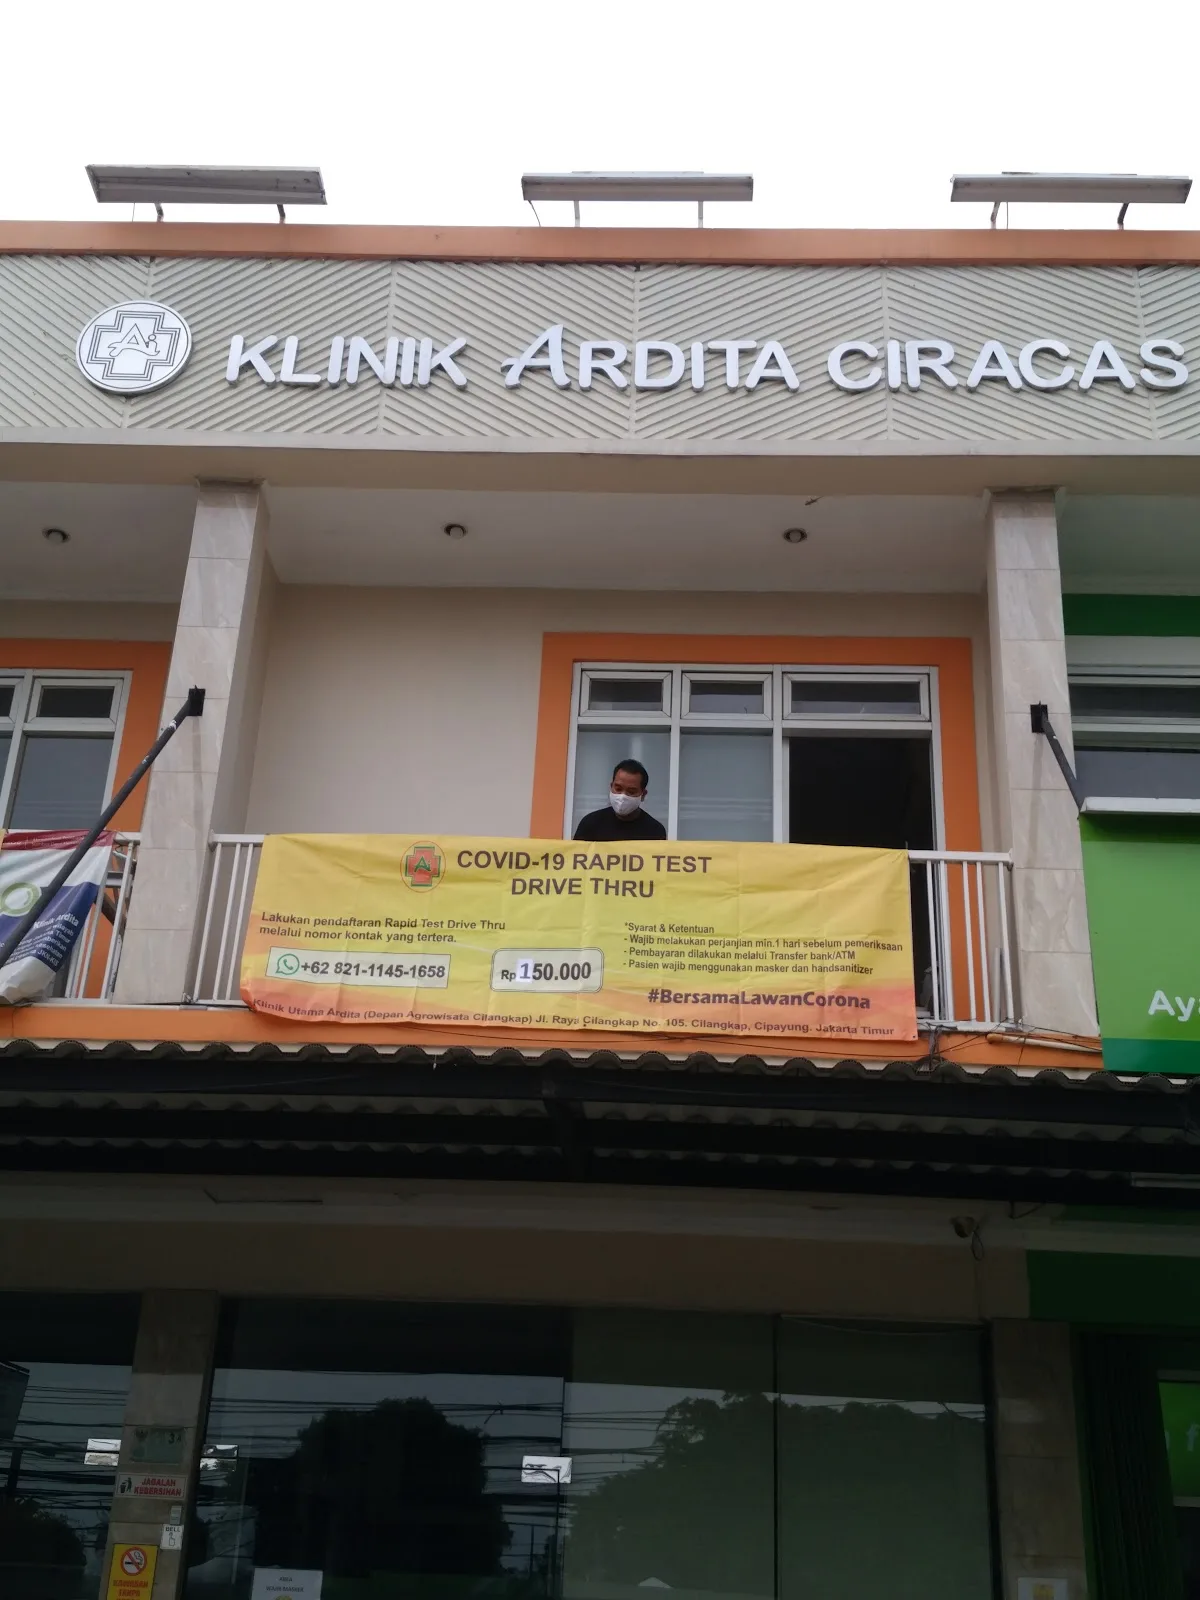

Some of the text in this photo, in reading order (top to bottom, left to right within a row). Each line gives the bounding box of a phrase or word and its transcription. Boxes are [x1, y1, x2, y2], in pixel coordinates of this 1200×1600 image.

[225, 324, 1189, 393] KLINIK ARDITA CIRACAS
[457, 850, 712, 874] COVID-19 RAPID TEST
[511, 878, 654, 898] DRIVE THRU
[262, 912, 506, 930] Lakukan pendaftaran Rapid Test Drive Thru
[659, 924, 666, 932] &
[668, 924, 714, 934] Ketentuan
[260, 926, 456, 944] melalui nomor kontak yang tertera.
[630, 935, 654, 946] Wajib
[656, 936, 705, 946] melakukan
[708, 937, 752, 948] perjanjian
[756, 939, 780, 948] min.1
[782, 938, 800, 948] hari
[803, 938, 842, 948] sebelum
[844, 940, 903, 951] pemeriksaan
[630, 948, 686, 958] Pembayaran
[688, 950, 732, 960] dilakukan
[734, 950, 766, 960] melalui
[770, 951, 808, 960] Transfer
[810, 951, 856, 960] bank/ATM
[301, 962, 446, 978] +62 821-1145-1658
[628, 960, 660, 970] Pasien
[662, 960, 686, 972] wajib
[688, 963, 752, 973] menggunakan
[755, 964, 790, 972] masker
[792, 964, 808, 972] dan
[812, 964, 874, 974] handsanitizer
[648, 988, 870, 1008] #BersamaLawanCorona
[1148, 990, 1200, 1022] Ay
[253, 998, 284, 1012] Klinik
[288, 1006, 324, 1016] Utama
[326, 1008, 360, 1018] Ardita
[364, 1010, 404, 1020] (Depan
[406, 1010, 470, 1021] Agrowisata
[473, 1013, 532, 1024] Cilangkap)
[536, 1014, 548, 1024] Jl.
[552, 1015, 579, 1025] Raya
[583, 1016, 639, 1026] Cilangkap
[816, 1024, 858, 1034] Jakarta
[860, 1026, 894, 1035] Timur
